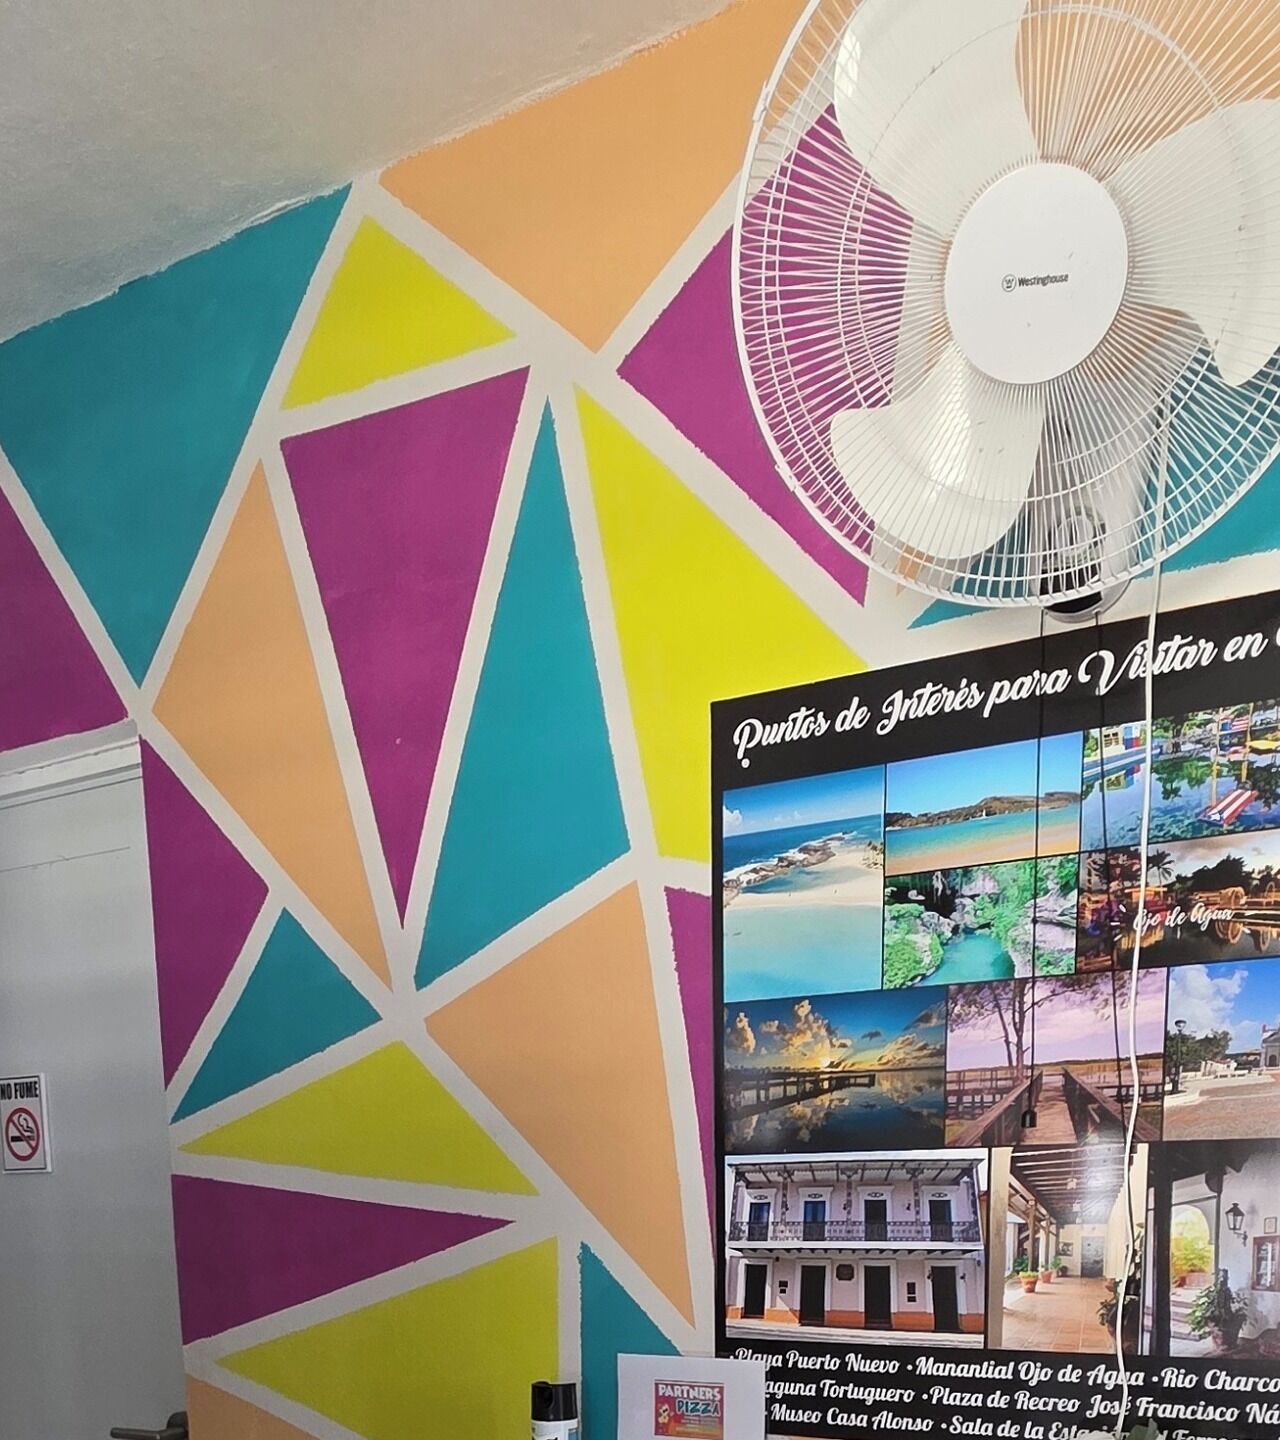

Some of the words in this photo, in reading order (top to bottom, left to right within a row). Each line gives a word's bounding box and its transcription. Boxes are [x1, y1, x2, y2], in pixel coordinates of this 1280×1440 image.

[1018, 273, 1069, 287] Westinghouse
[733, 706, 830, 760] Puntos
[835, 696, 871, 732] de
[876, 678, 984, 735] Interés
[983, 667, 1072, 718] para
[1078, 634, 1218, 696] Visitar
[1223, 633, 1269, 662] en
[1165, 905, 1188, 927] de
[1190, 902, 1235, 931] Agua
[0, 1083, 12, 1100] NO
[13, 1081, 39, 1100] FUME
[735, 1347, 783, 1371] Playa
[786, 1350, 841, 1371] Puerto
[845, 1352, 900, 1374] Nuevo
[915, 1356, 1014, 1380] Manantial
[1018, 1360, 1053, 1387] Ojo
[1057, 1364, 1082, 1383] de
[1086, 1364, 1145, 1390] Agua
[1160, 1367, 1199, 1389] Rio
[658, 1383, 721, 1401] PARTNERS
[765, 1380, 816, 1399] aguna
[820, 1379, 915, 1406] Tortuguero
[929, 1386, 983, 1408] Plaza
[986, 1390, 1011, 1409] de
[1014, 1390, 1081, 1413] Recreo
[1085, 1394, 1132, 1418] José
[1135, 1397, 1241, 1422] Francisco
[676, 1400, 721, 1417] PIZZA
[770, 1403, 823, 1424] Museo
[826, 1407, 868, 1428] Casa
[871, 1410, 934, 1432] Alonso
[948, 1415, 996, 1437] Sala
[996, 1419, 1021, 1438] de
[1023, 1421, 1045, 1440] la
